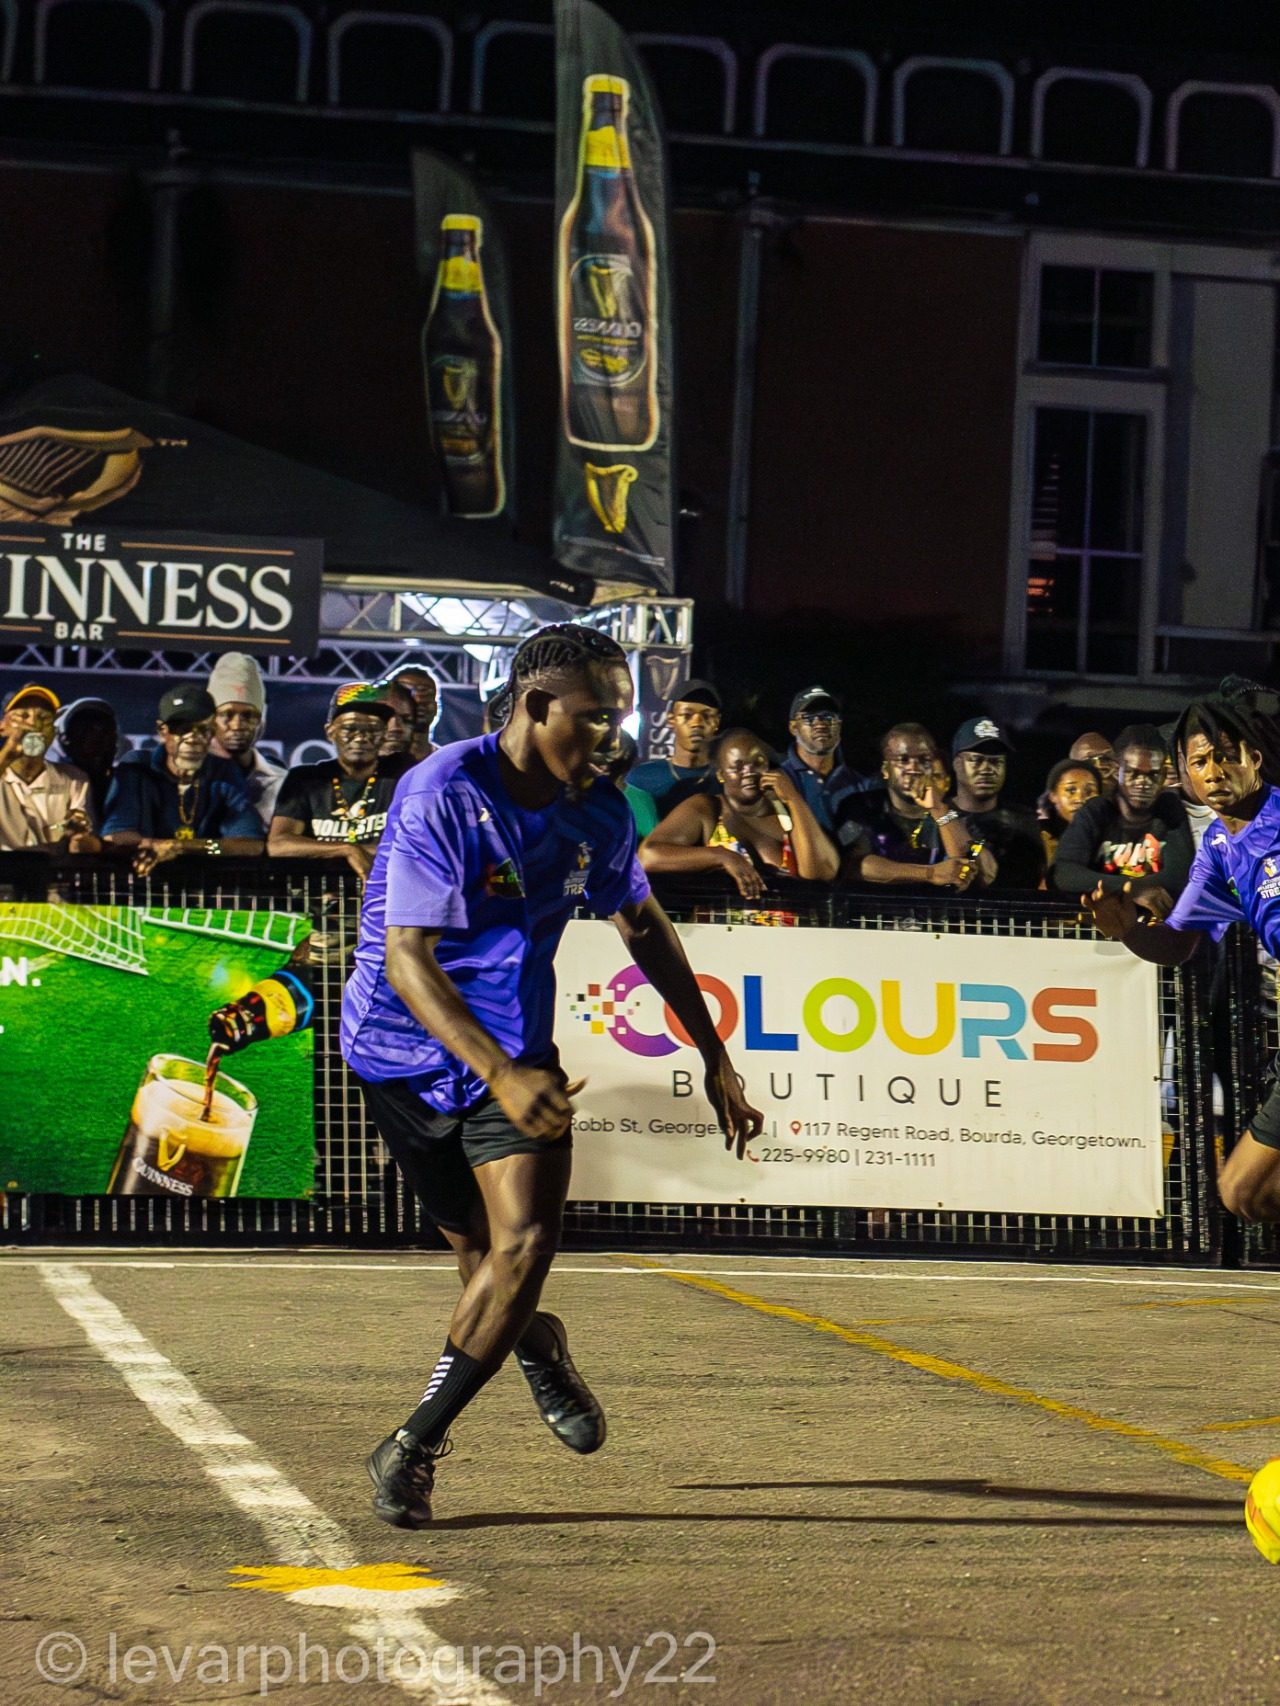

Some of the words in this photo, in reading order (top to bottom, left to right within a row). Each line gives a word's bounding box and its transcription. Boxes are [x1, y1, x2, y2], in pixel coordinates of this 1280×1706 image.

[61, 533, 107, 551] THE
[0, 553, 293, 632] INNESS
[55, 622, 104, 641] BAR
[311, 812, 388, 838] HOLLSTE
[672, 1069, 1002, 1108] BUTIQUE
[620, 1118, 643, 1134] St,
[804, 1122, 831, 1137] 117
[837, 1123, 900, 1141] Regent
[905, 1126, 954, 1143] Road,
[960, 1128, 1027, 1146] Bourda,
[1032, 1131, 1147, 1150] Georgetown.
[761, 1148, 850, 1164] 225-9980
[865, 1150, 936, 1167] 231-1111
[132, 1157, 194, 1197] GUINNESS
